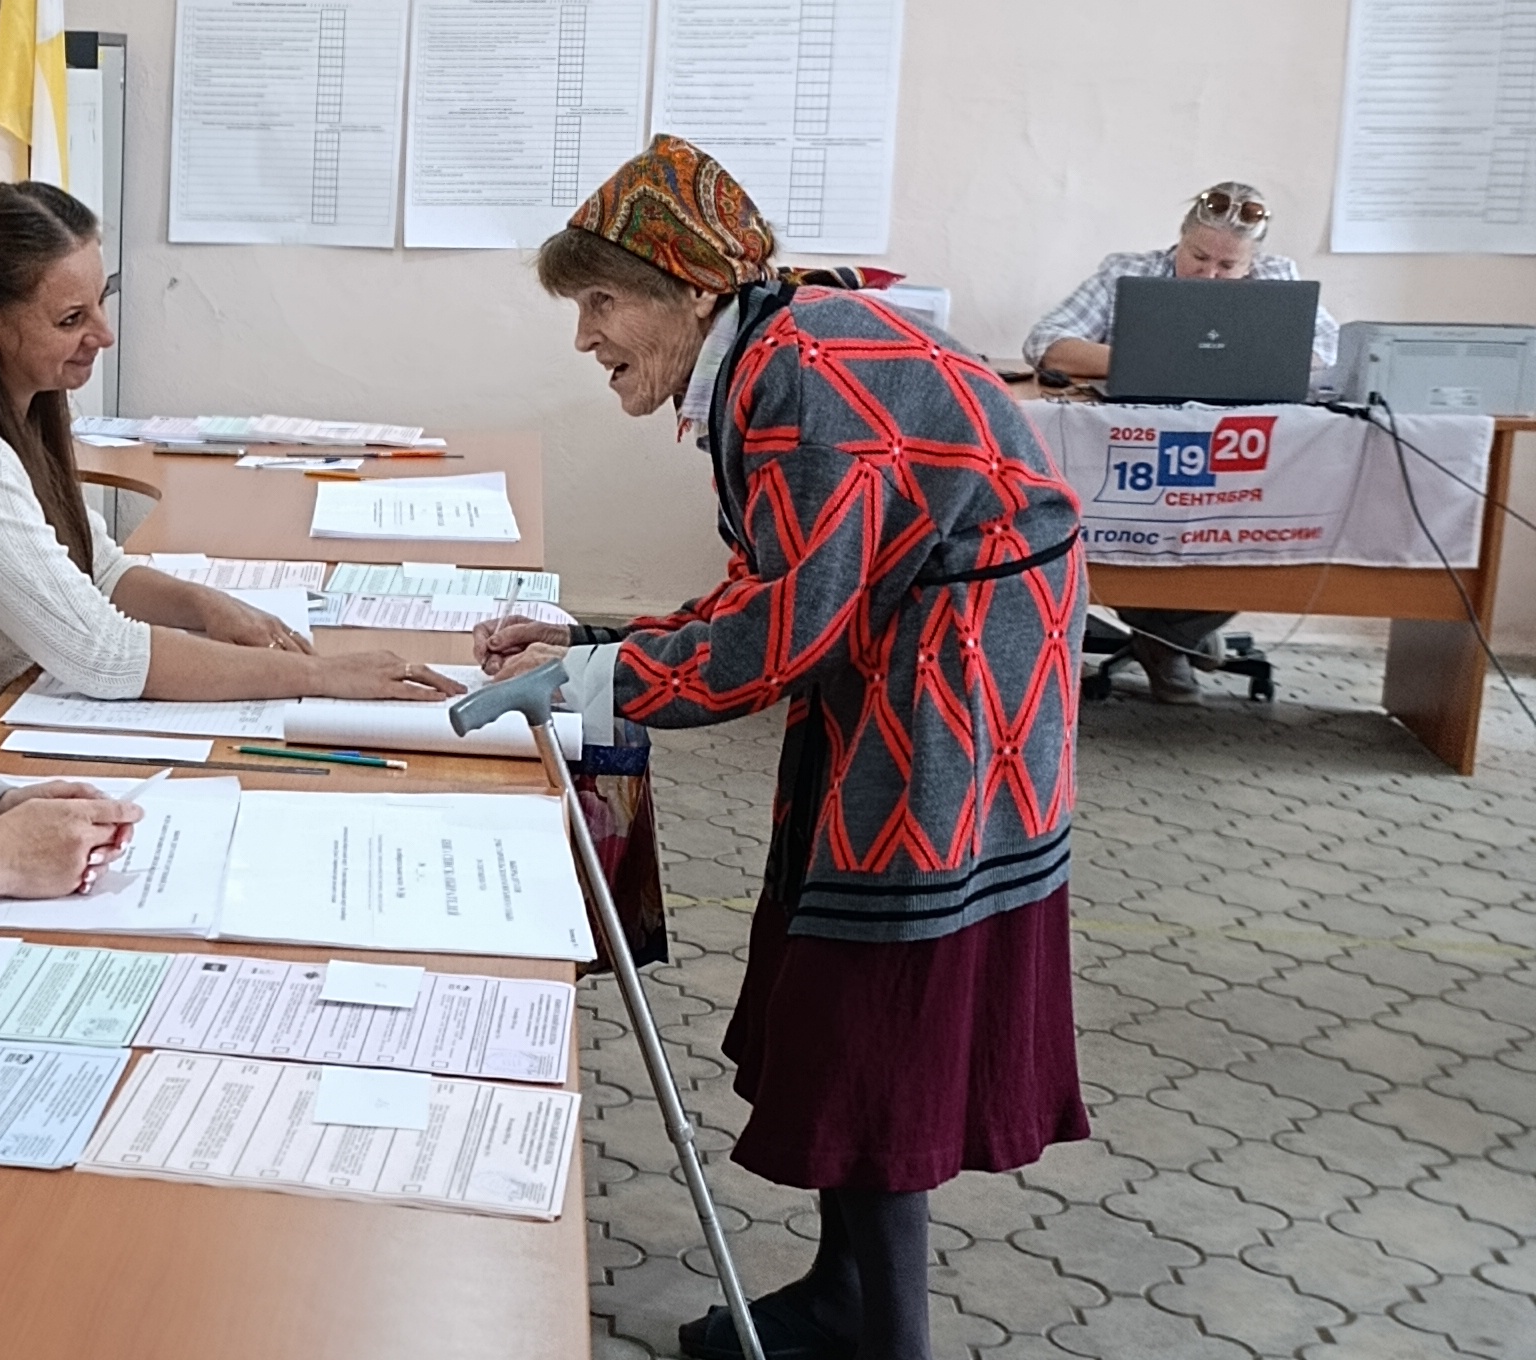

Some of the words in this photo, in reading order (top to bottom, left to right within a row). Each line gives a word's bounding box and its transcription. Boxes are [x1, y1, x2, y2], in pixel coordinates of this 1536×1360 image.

[1110, 427, 1156, 441] 2026
[1113, 461, 1154, 491] 18
[1164, 445, 1206, 476] 19
[1214, 428, 1266, 460] 20
[1165, 488, 1263, 506] СЕНТЯБРЯ
[1095, 529, 1159, 545] ГОЛОС
[1180, 530, 1233, 545] СИЛА
